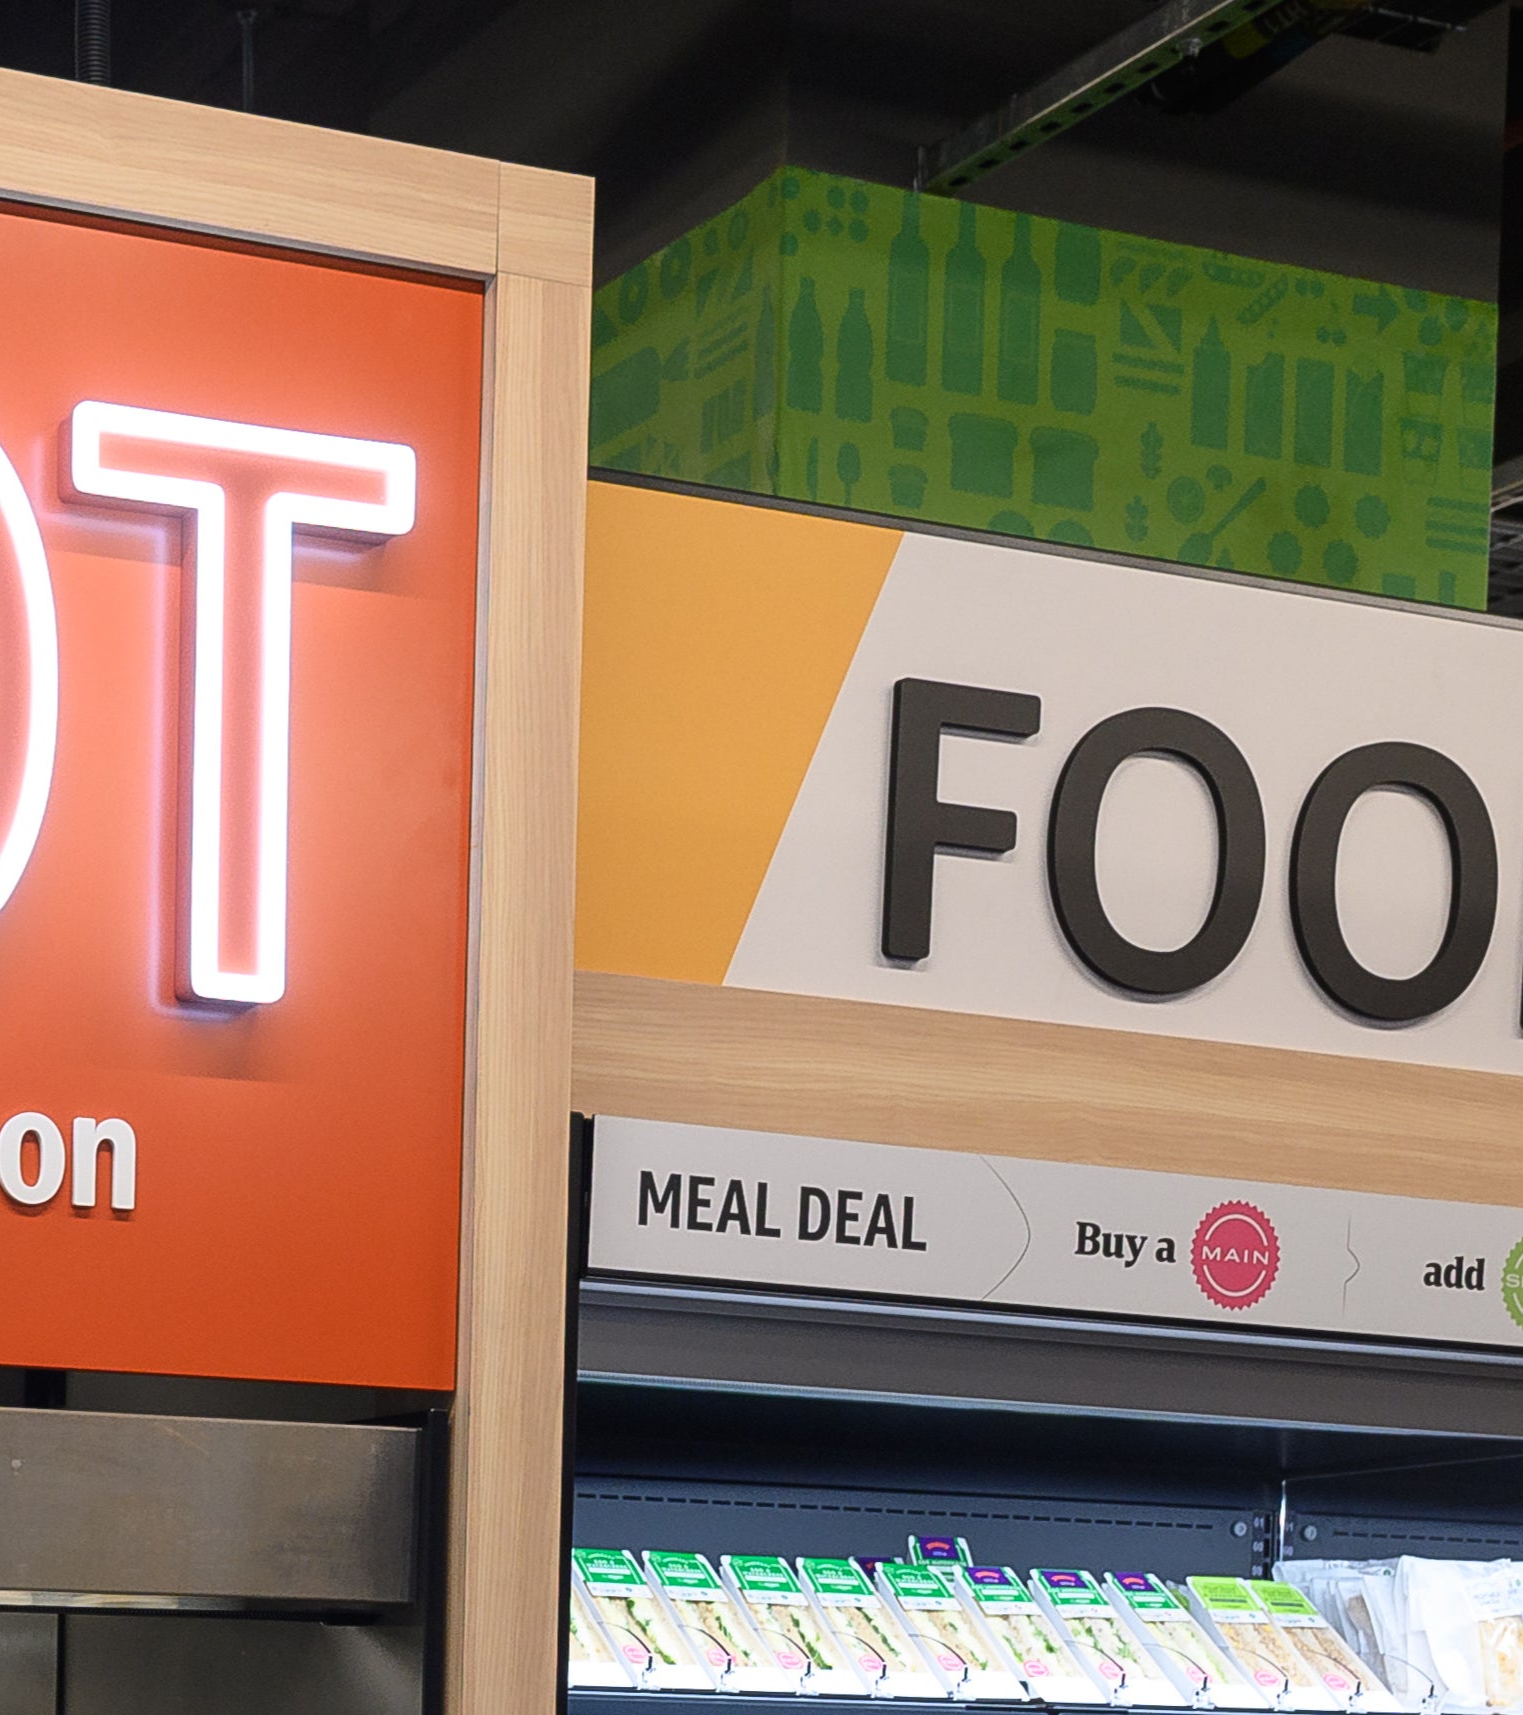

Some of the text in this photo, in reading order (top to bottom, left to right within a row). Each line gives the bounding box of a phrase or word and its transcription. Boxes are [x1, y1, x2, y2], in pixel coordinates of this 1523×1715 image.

[637, 1169, 928, 1253] MEAL DEAL
[1075, 1221, 1270, 1269] Buy a MAIN
[1422, 1255, 1485, 1292] add
